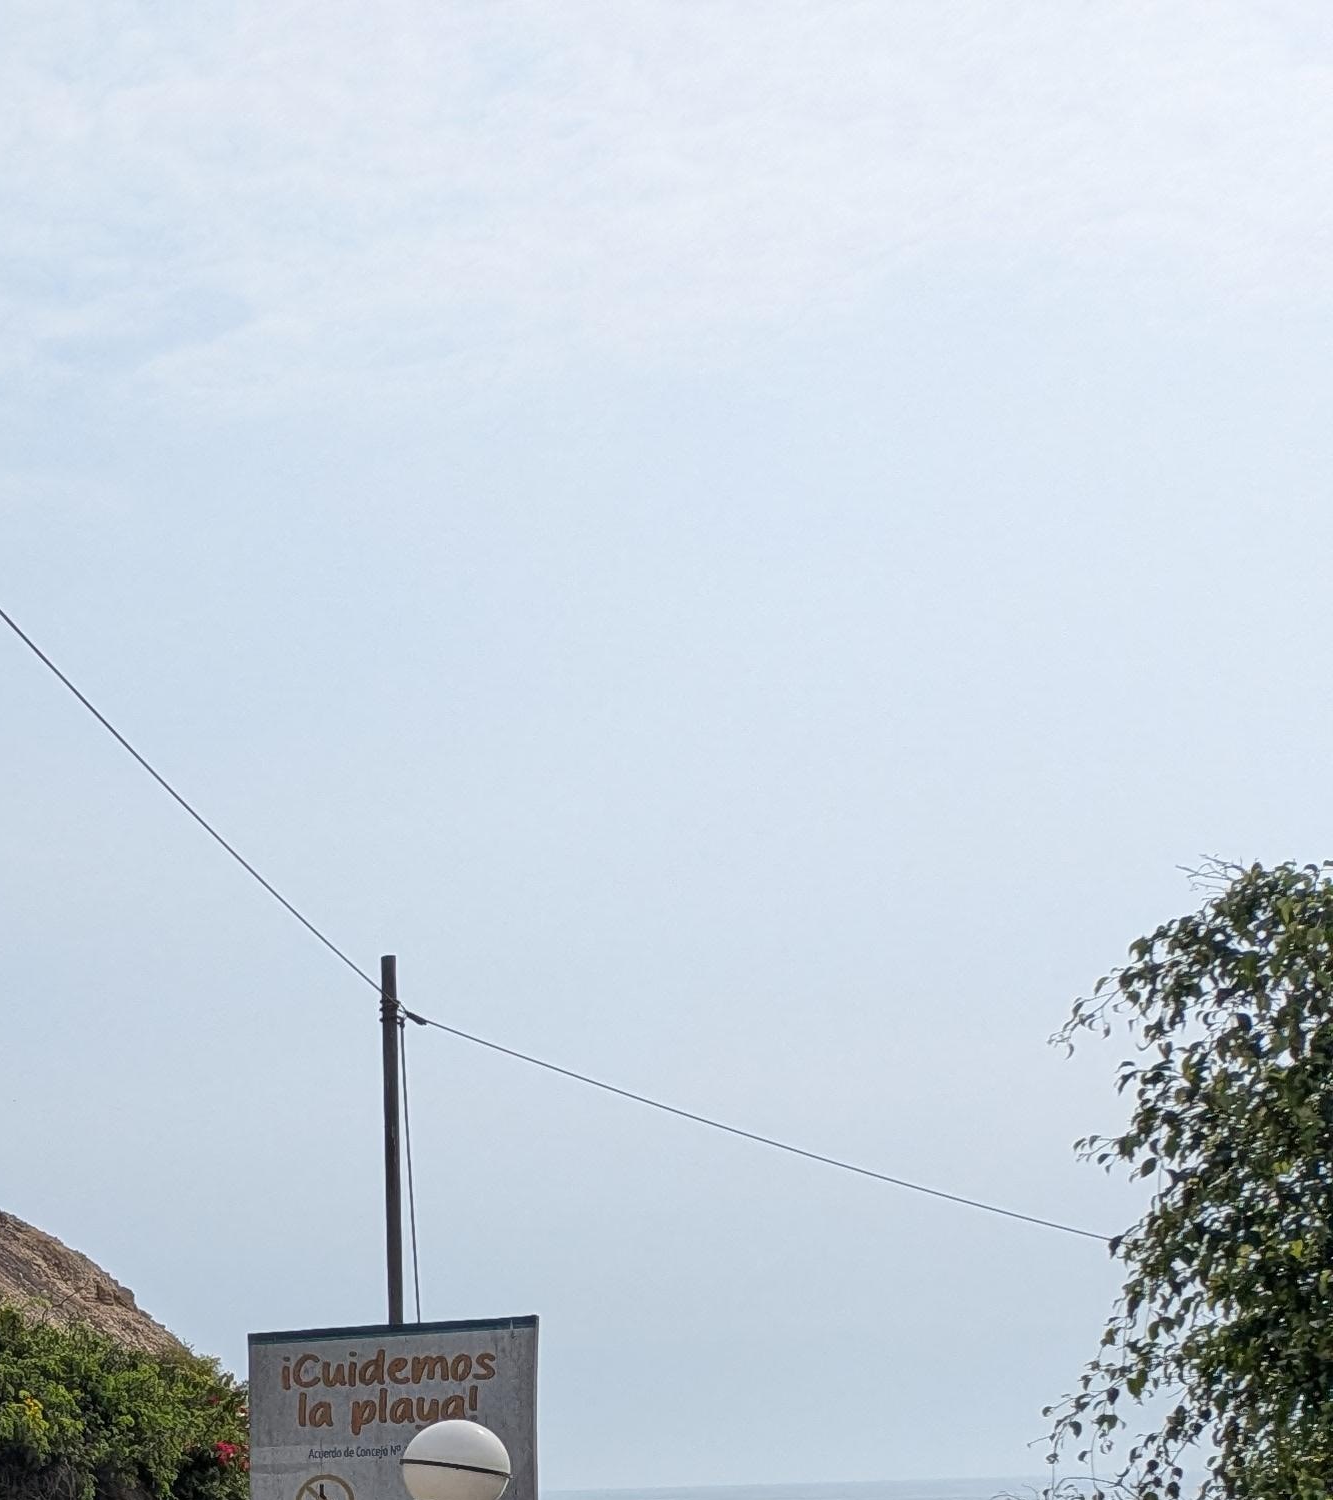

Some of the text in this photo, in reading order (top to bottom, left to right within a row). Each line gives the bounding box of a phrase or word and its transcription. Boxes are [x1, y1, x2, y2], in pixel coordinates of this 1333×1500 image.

[281, 1349, 496, 1390] ¡Cuidemos
[297, 1386, 479, 1435] la playa!
[308, 1447, 342, 1459] Acuerdo
[343, 1446, 354, 1458] de
[356, 1445, 388, 1459] Concejo
